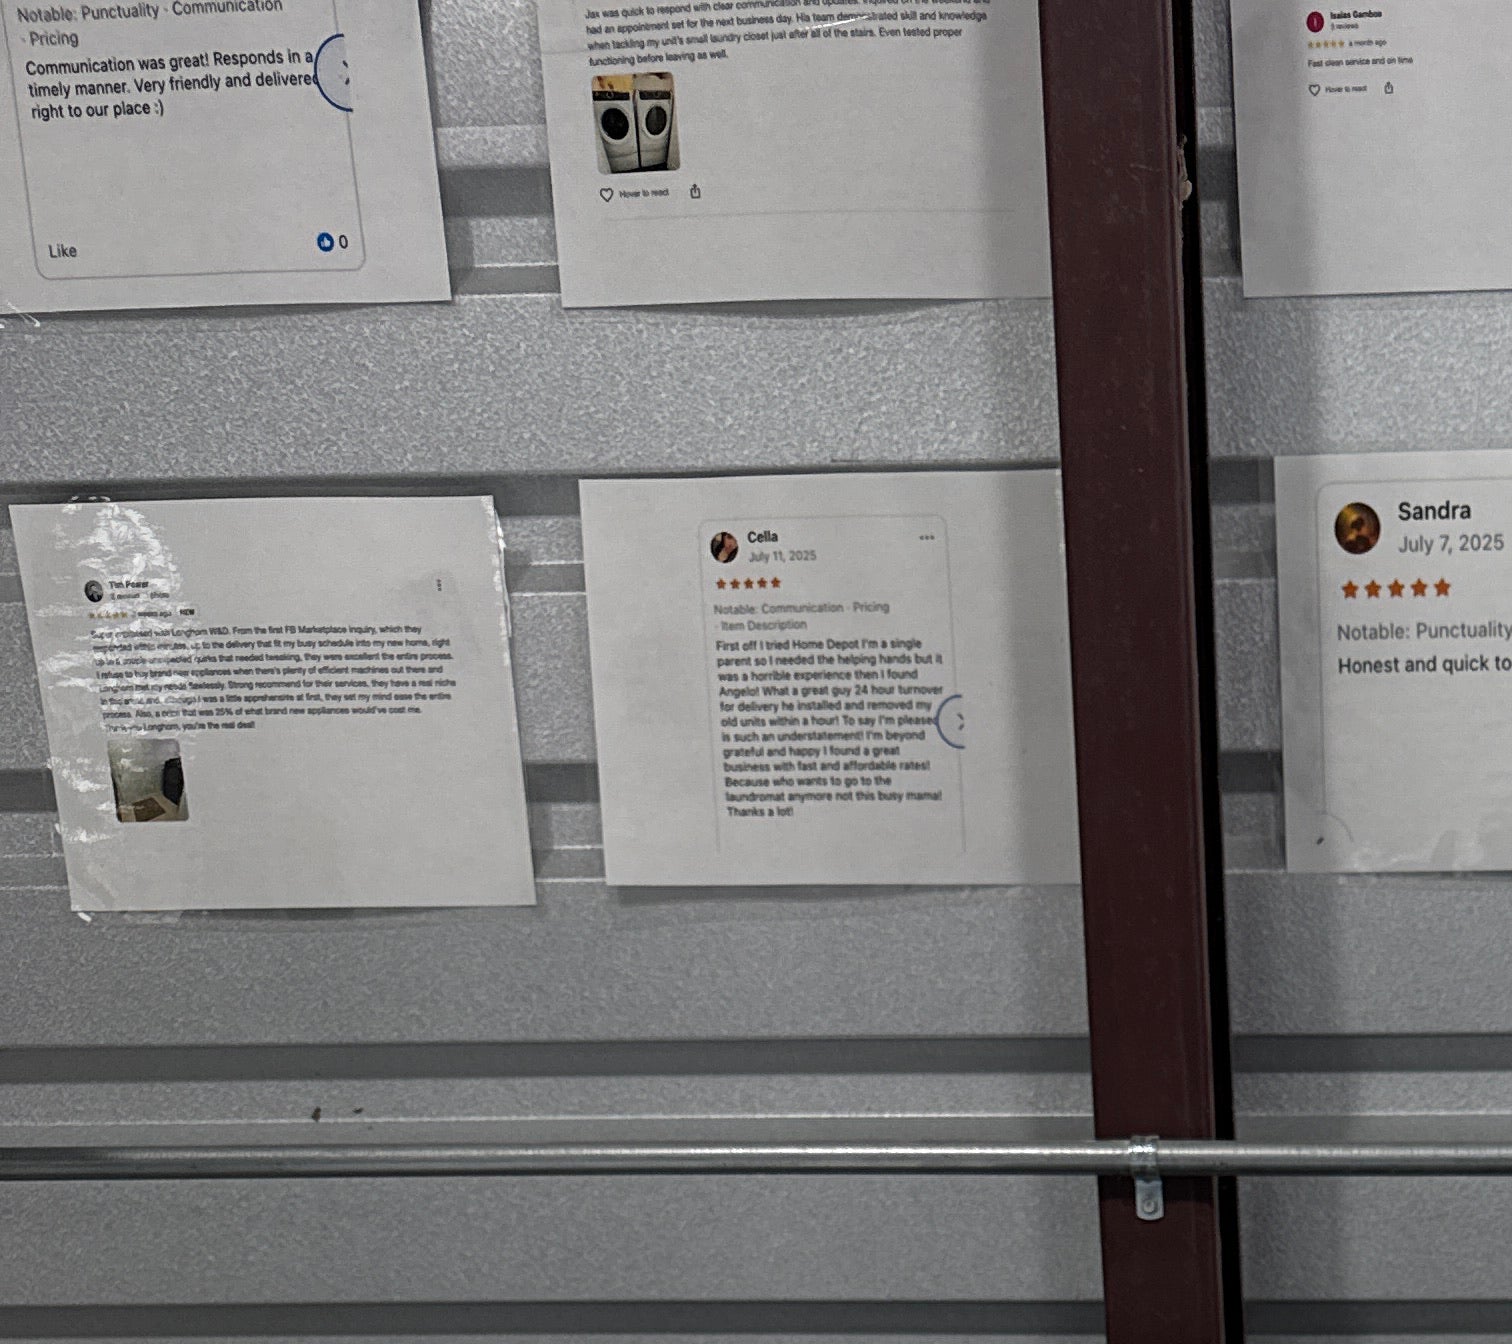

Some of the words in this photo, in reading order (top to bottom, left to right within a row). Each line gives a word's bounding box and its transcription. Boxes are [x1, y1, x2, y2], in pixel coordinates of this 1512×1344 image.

[16, 6, 77, 23] Notable:
[80, 2, 159, 20] Punctuality
[171, 0, 283, 16] Communication
[29, 30, 79, 48] Pricing
[25, 56, 135, 76] Communication
[137, 57, 166, 70] was
[169, 52, 209, 72] great!
[212, 50, 284, 68] Responds
[287, 49, 301, 63] in
[305, 52, 314, 63] a
[28, 82, 70, 99] timely
[74, 82, 130, 95] manner.
[133, 78, 165, 95] Very
[168, 76, 221, 92] friendly
[225, 74, 251, 88] and
[31, 103, 64, 122] right
[67, 104, 82, 118] to
[85, 105, 109, 117] our
[112, 100, 150, 119] place
[338, 235, 348, 249] 0
[49, 244, 77, 259] Like
[1398, 500, 1471, 521] Sandra
[747, 530, 778, 543] Cella
[1398, 535, 1434, 556] July
[1439, 534, 1452, 555] 7,
[1459, 533, 1504, 551] 2025
[748, 551, 770, 564] July
[772, 550, 786, 563] 11,
[789, 550, 817, 561] 2025
[713, 604, 757, 615] Notable:
[761, 603, 844, 614] Communication
[852, 601, 890, 614] Pricing
[720, 621, 745, 631] Item
[746, 620, 807, 631] Description
[1337, 622, 1410, 641] Notable:
[1338, 657, 1400, 674] Honest
[1404, 655, 1437, 673] and
[1442, 654, 1489, 675] quick
[1494, 655, 1512, 671] to
[726, 806, 765, 817] Thanks
[767, 808, 774, 817] a
[776, 806, 793, 816] lot!
